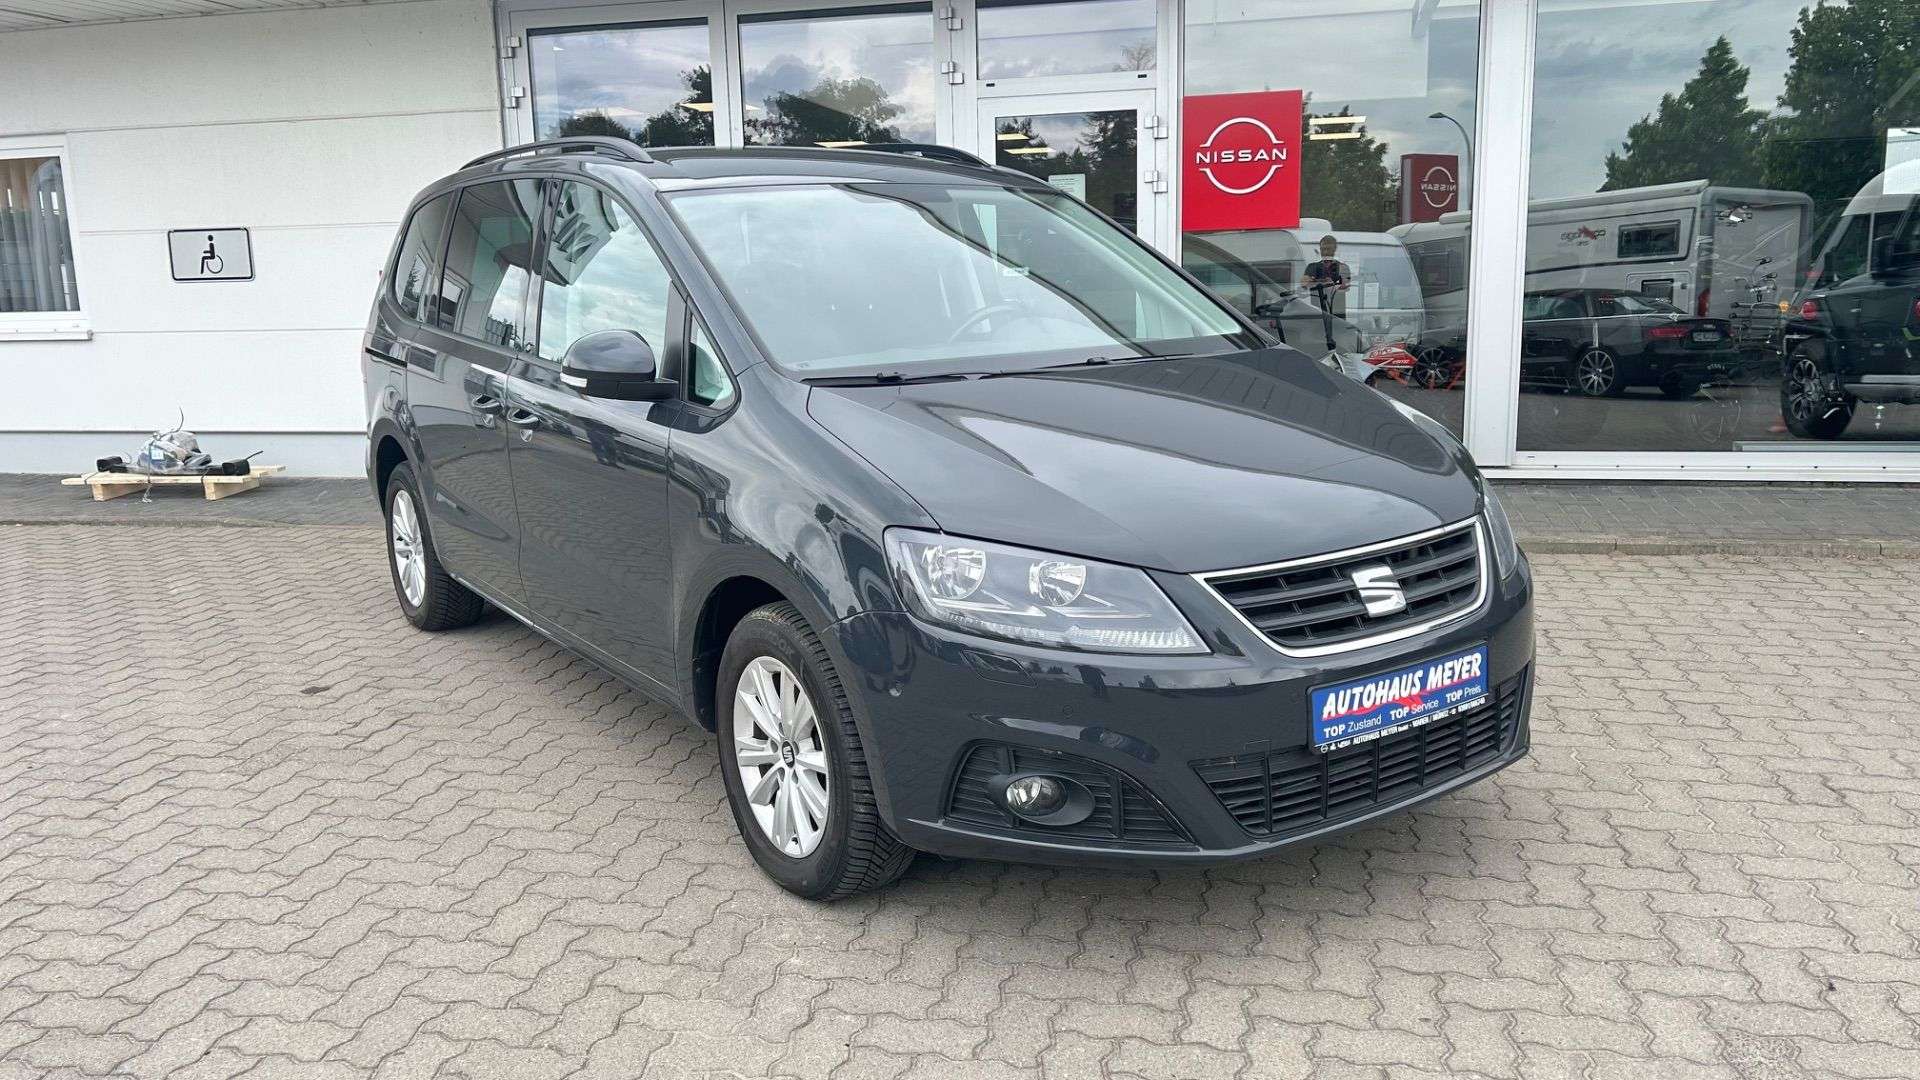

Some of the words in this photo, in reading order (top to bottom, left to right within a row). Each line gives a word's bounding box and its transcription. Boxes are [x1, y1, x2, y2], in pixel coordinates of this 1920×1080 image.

[1195, 148, 1287, 164] NISSAN
[1322, 669, 1424, 719] AUTOHAUS
[1426, 652, 1482, 691] MEYER
[1323, 724, 1346, 739] TOP
[1347, 714, 1382, 733] Zustand
[1390, 706, 1410, 721] TOP
[1411, 699, 1439, 714] Service
[1445, 689, 1463, 704] TOP
[1464, 684, 1482, 698] Preis
